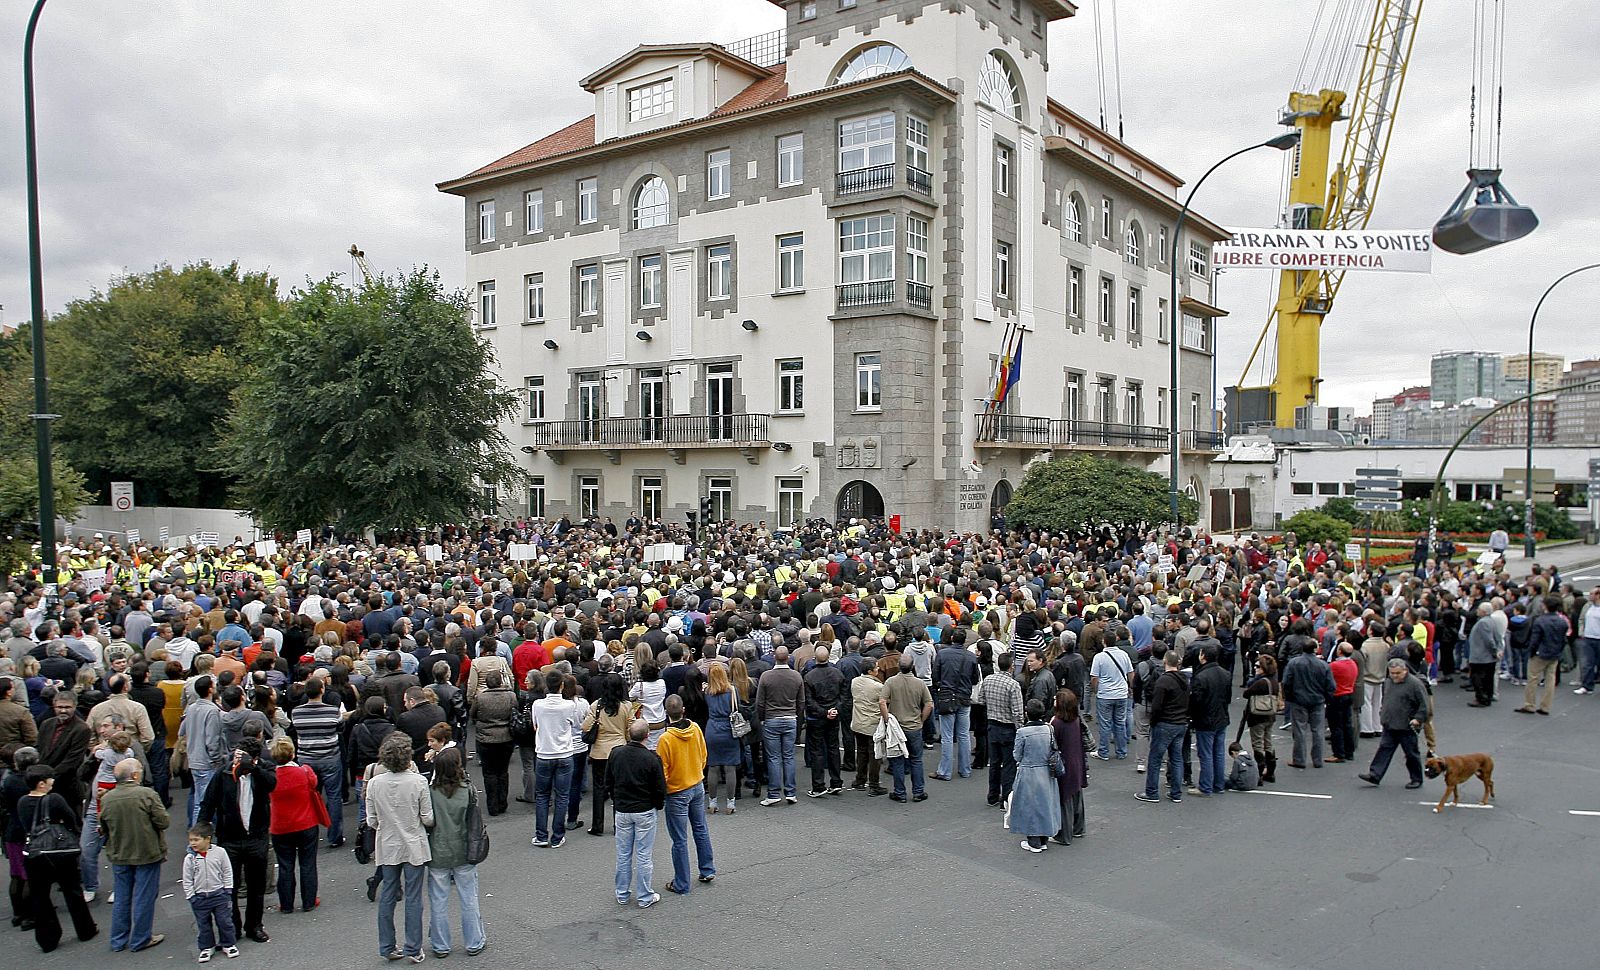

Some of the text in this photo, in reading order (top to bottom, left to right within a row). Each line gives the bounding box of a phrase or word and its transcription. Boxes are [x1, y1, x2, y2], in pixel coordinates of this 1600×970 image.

[1313, 235, 1325, 248] Y
[1335, 235, 1358, 249] AS
[1363, 235, 1430, 252] PONTES
[1213, 252, 1384, 267] LIBRE COMPETENCIA
